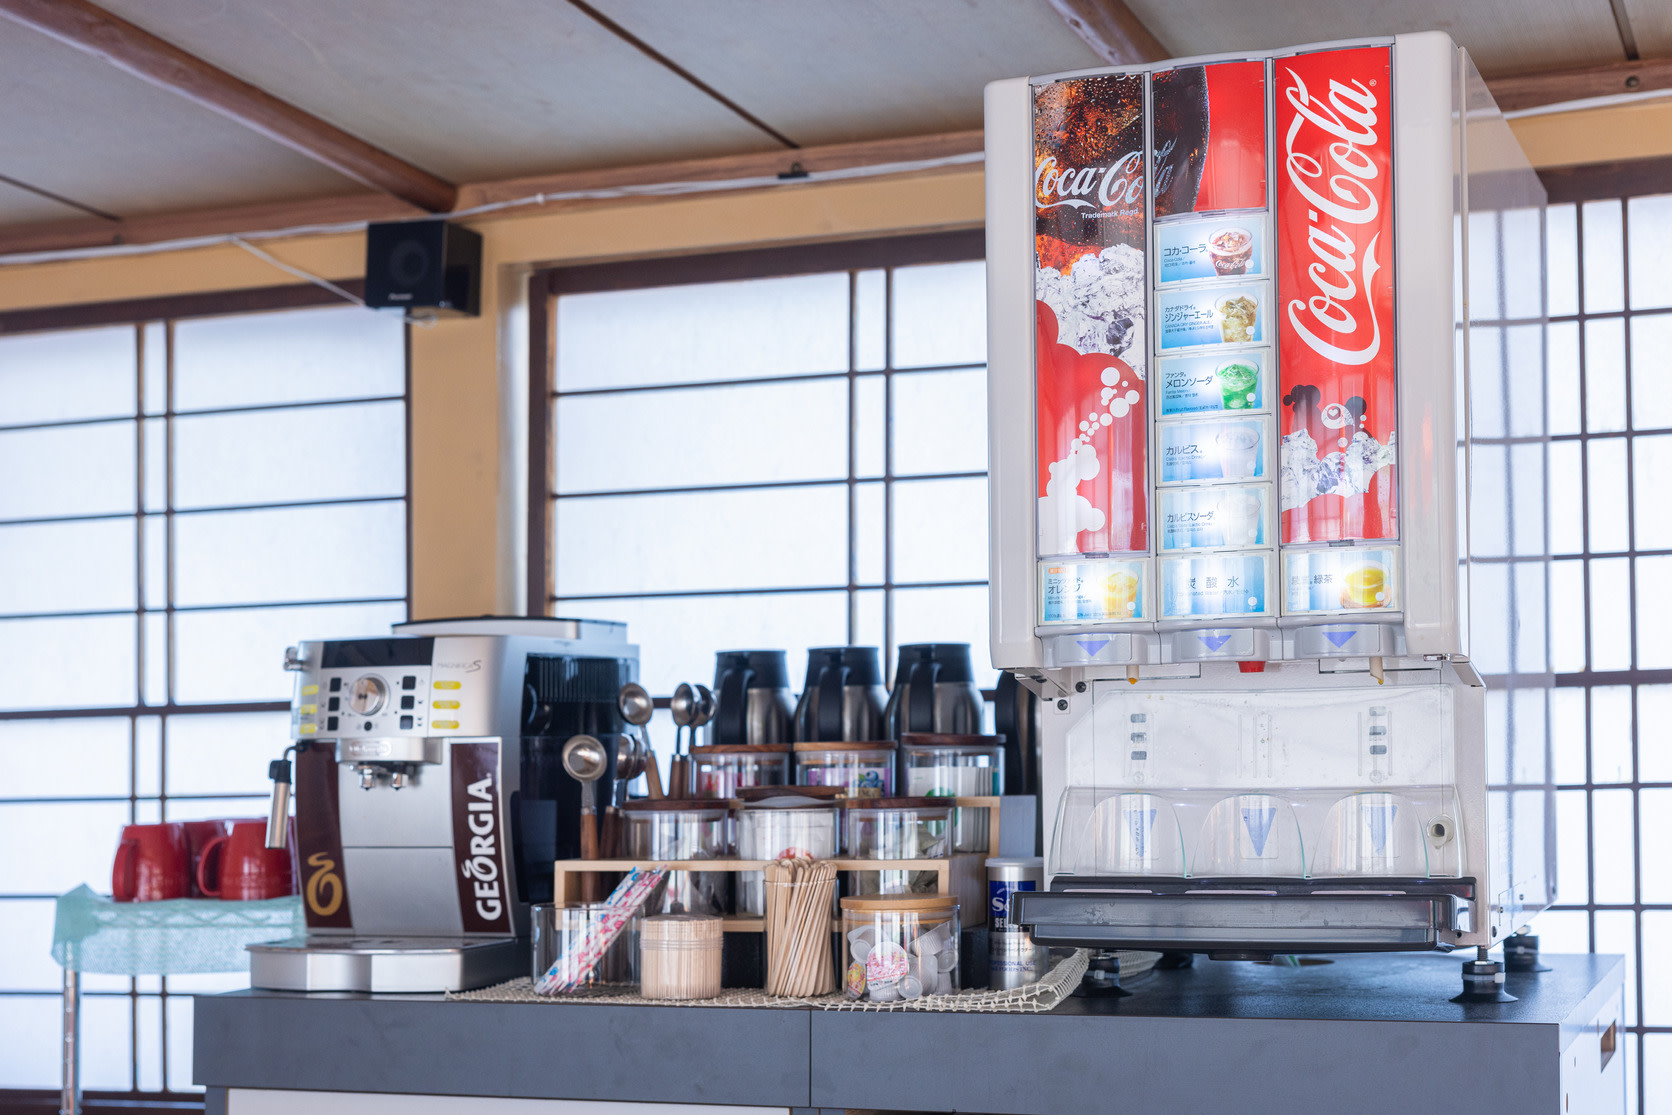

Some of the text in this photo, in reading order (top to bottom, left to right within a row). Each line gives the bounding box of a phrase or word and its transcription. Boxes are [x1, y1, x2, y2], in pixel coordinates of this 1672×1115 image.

[1081, 211, 1118, 219] Trademark
[1285, 66, 1381, 365] Coca-Cola
[1165, 309, 1214, 323] ジンジャーエール
[1166, 375, 1213, 389] メロンソーダ
[461, 776, 502, 921] GEORGIA
